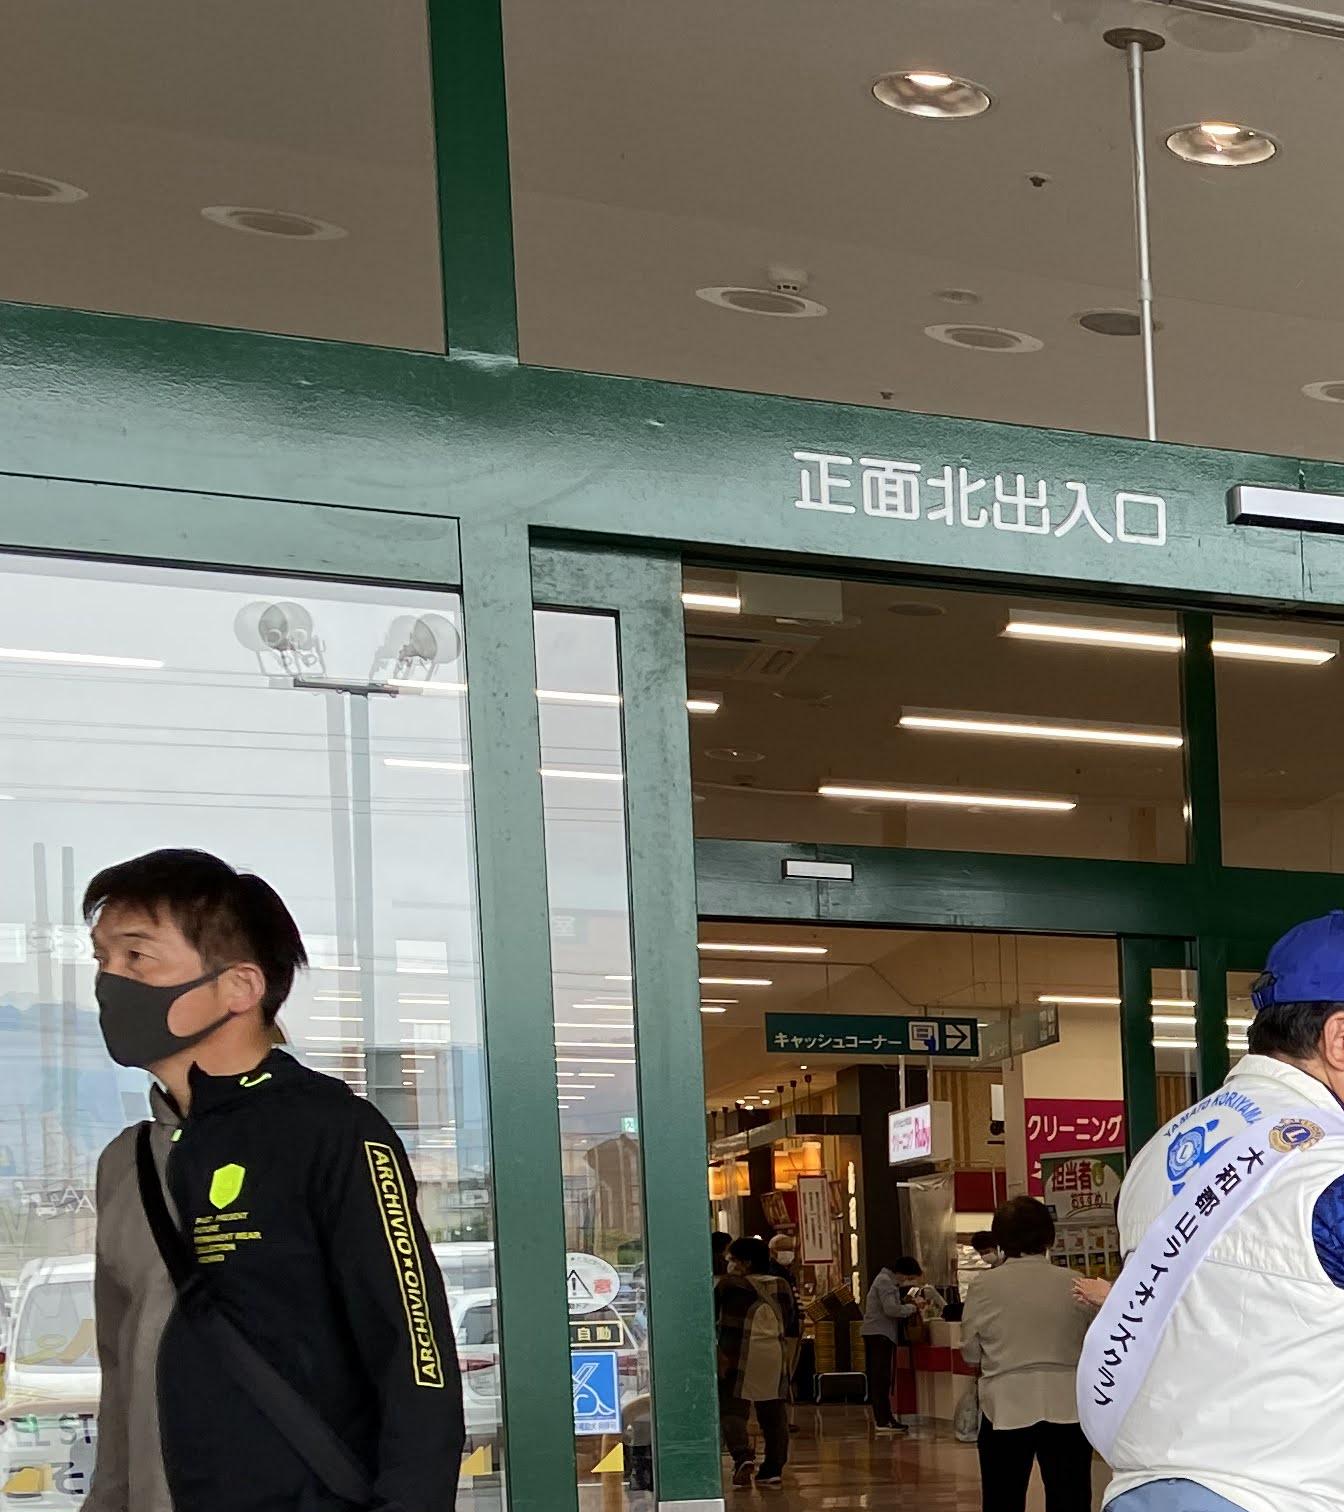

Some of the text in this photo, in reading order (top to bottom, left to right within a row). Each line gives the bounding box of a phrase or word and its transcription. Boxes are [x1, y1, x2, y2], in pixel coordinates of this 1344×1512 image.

[793, 451, 1167, 546] 正面北出入口
[774, 1031, 902, 1050] キャッシュコーナー
[1028, 1114, 1123, 1142] クリーニング
[372, 1149, 413, 1257] ARCHIVIO
[404, 1271, 437, 1380] ARCHIVIO
